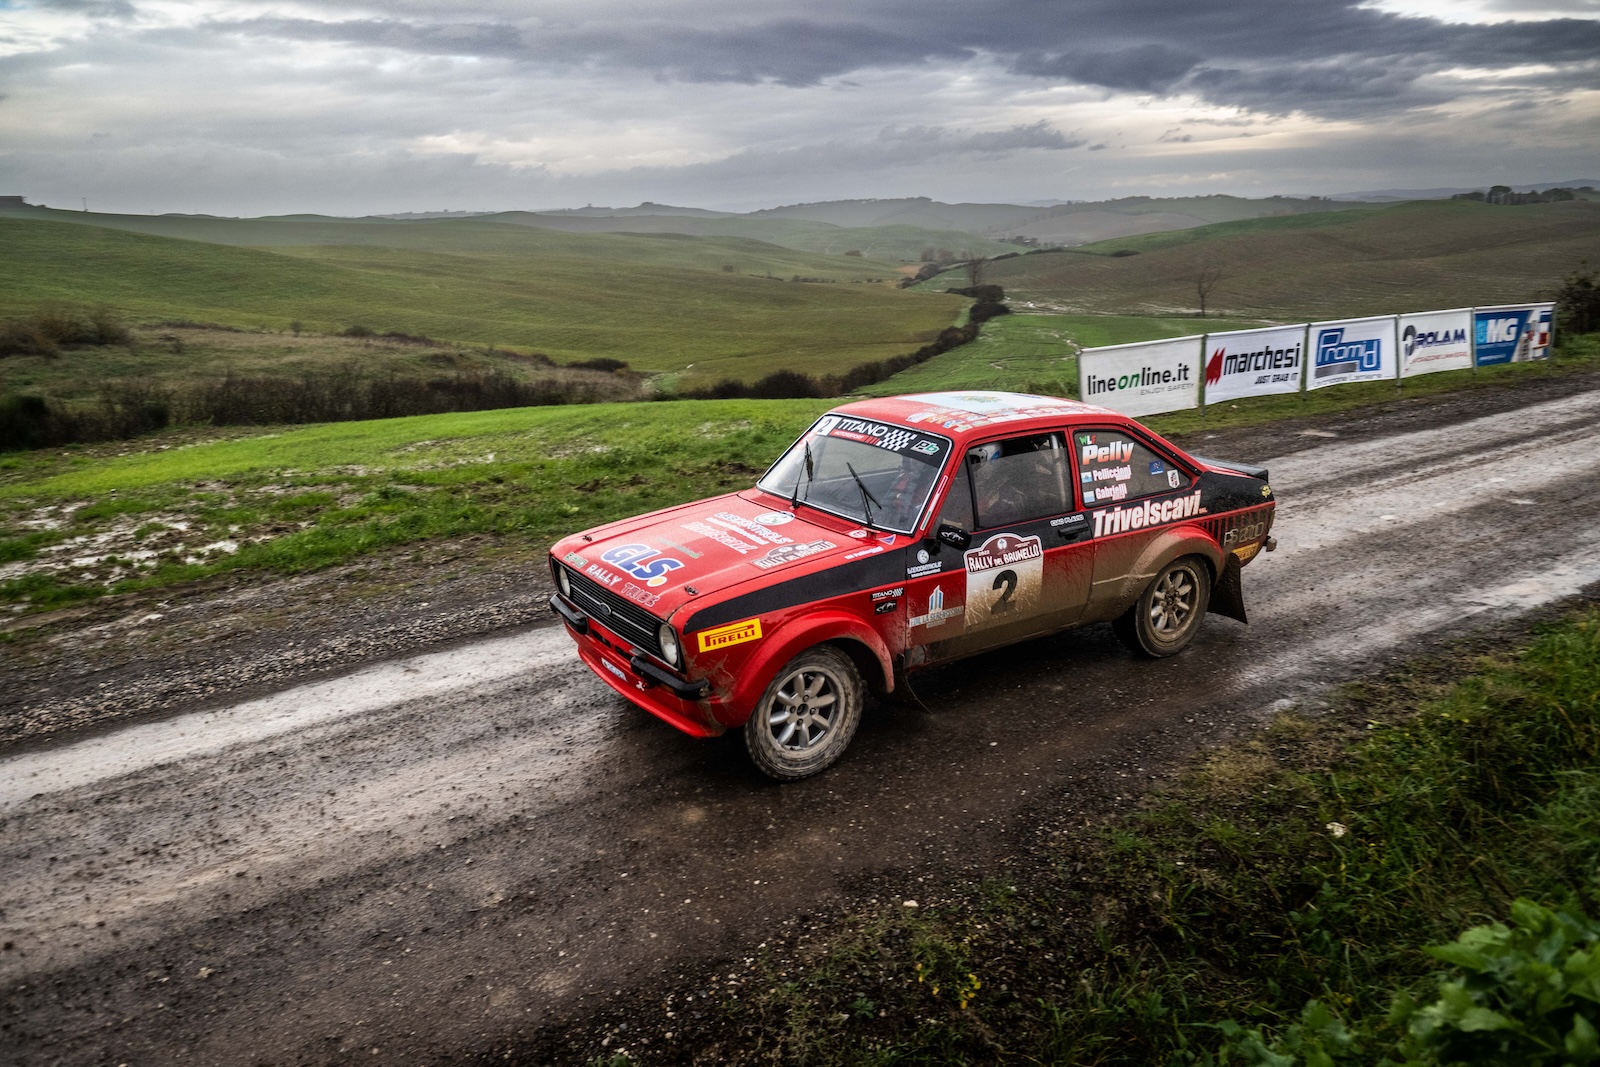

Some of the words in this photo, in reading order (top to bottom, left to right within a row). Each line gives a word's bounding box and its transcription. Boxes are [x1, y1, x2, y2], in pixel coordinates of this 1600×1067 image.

[1223, 343, 1301, 376] marchesi
[1087, 363, 1190, 396] lineonline.it
[1167, 382, 1194, 392] SAFETY
[1254, 375, 1271, 385] JUST
[1272, 373, 1289, 383] GRAB
[817, 418, 833, 433] 2
[837, 418, 889, 437] TITANO
[1082, 441, 1135, 465] Pelly
[1092, 490, 1202, 538] Trivelscavi
[968, 556, 994, 571] RALLY
[993, 557, 1005, 566] DEL
[1003, 544, 1040, 564] BRUNELLO
[586, 564, 622, 586] RALLY
[621, 582, 661, 608] TRIBE
[872, 589, 893, 599] TITANO
[990, 569, 1018, 615] 2
[704, 624, 756, 647] PIRELLI
